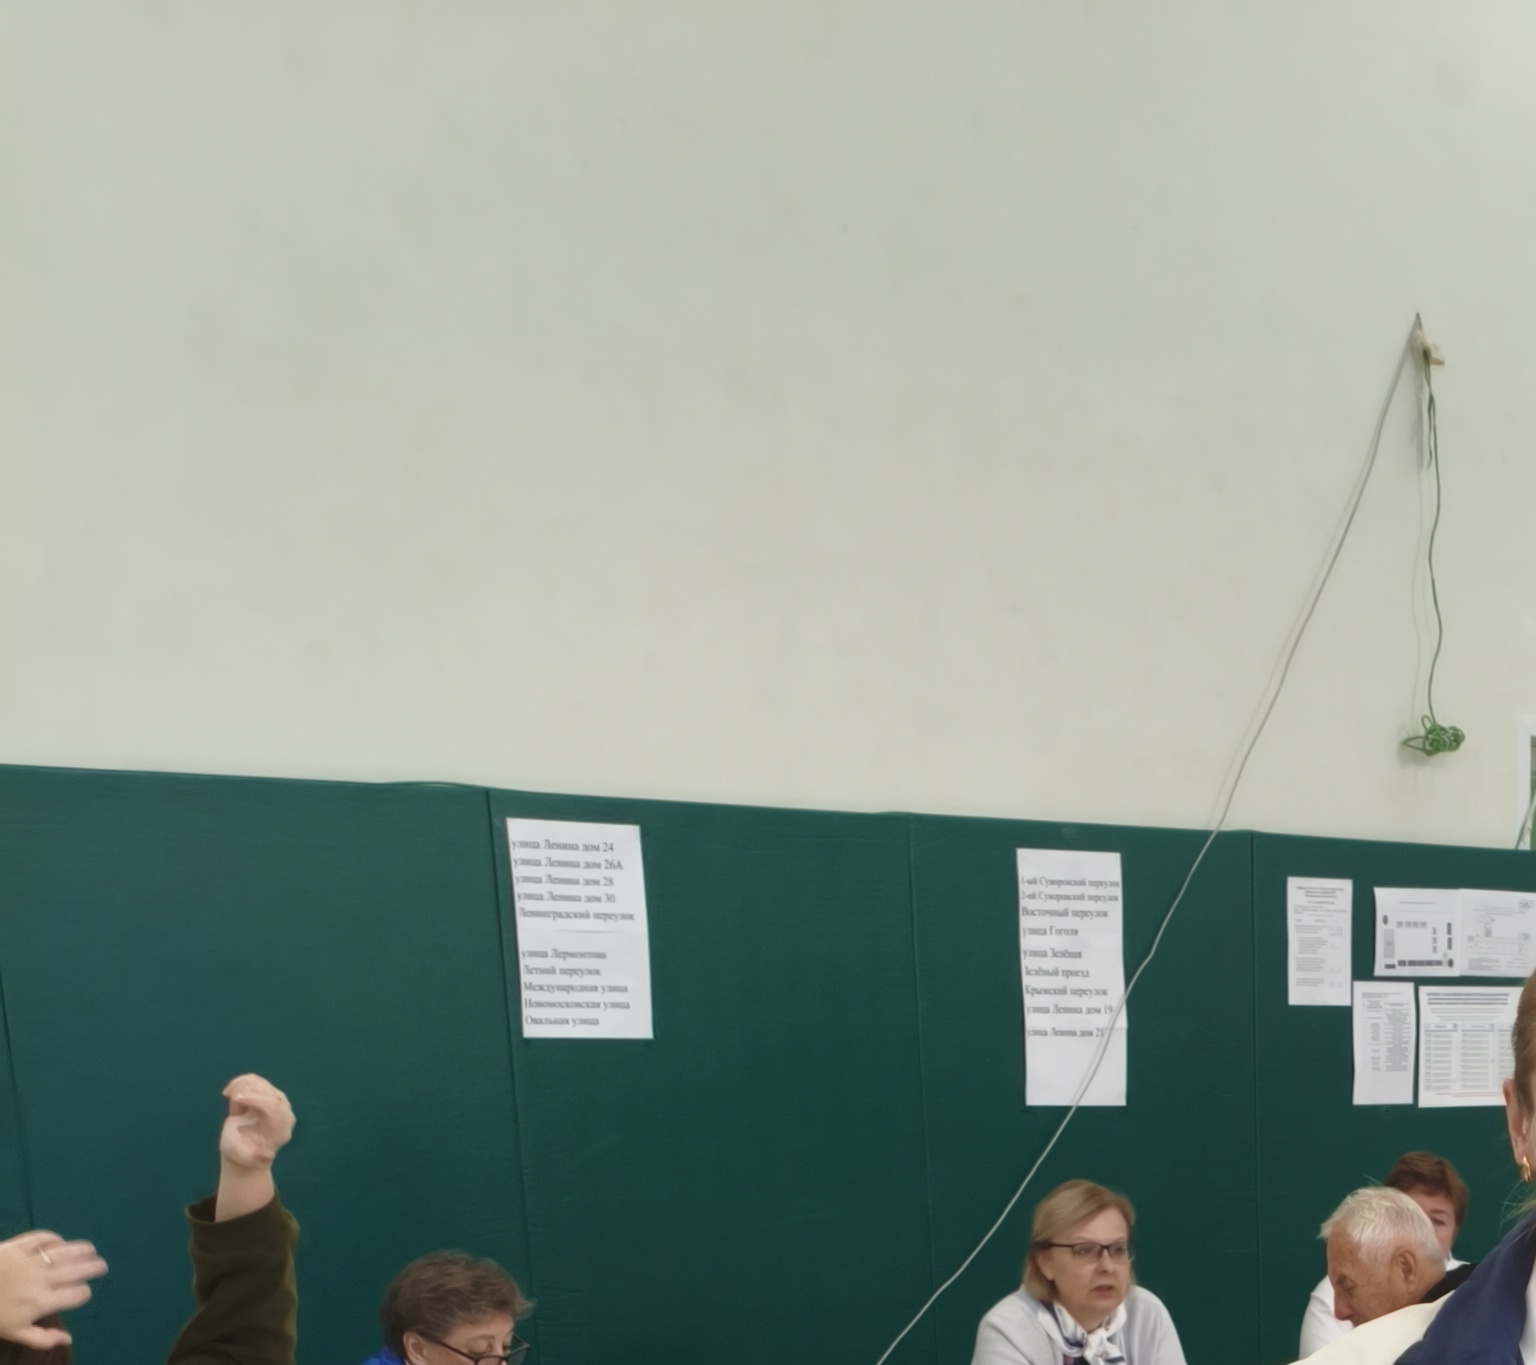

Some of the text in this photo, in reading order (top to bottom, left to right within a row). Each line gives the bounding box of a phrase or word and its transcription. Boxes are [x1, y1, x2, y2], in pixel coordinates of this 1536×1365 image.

[544, 839, 579, 851] Ленина
[582, 843, 600, 852] дом
[603, 841, 614, 852] 24
[544, 857, 580, 869] Ленина
[583, 861, 601, 870] дом
[544, 874, 580, 885] Ленина
[546, 891, 581, 902] Ленина
